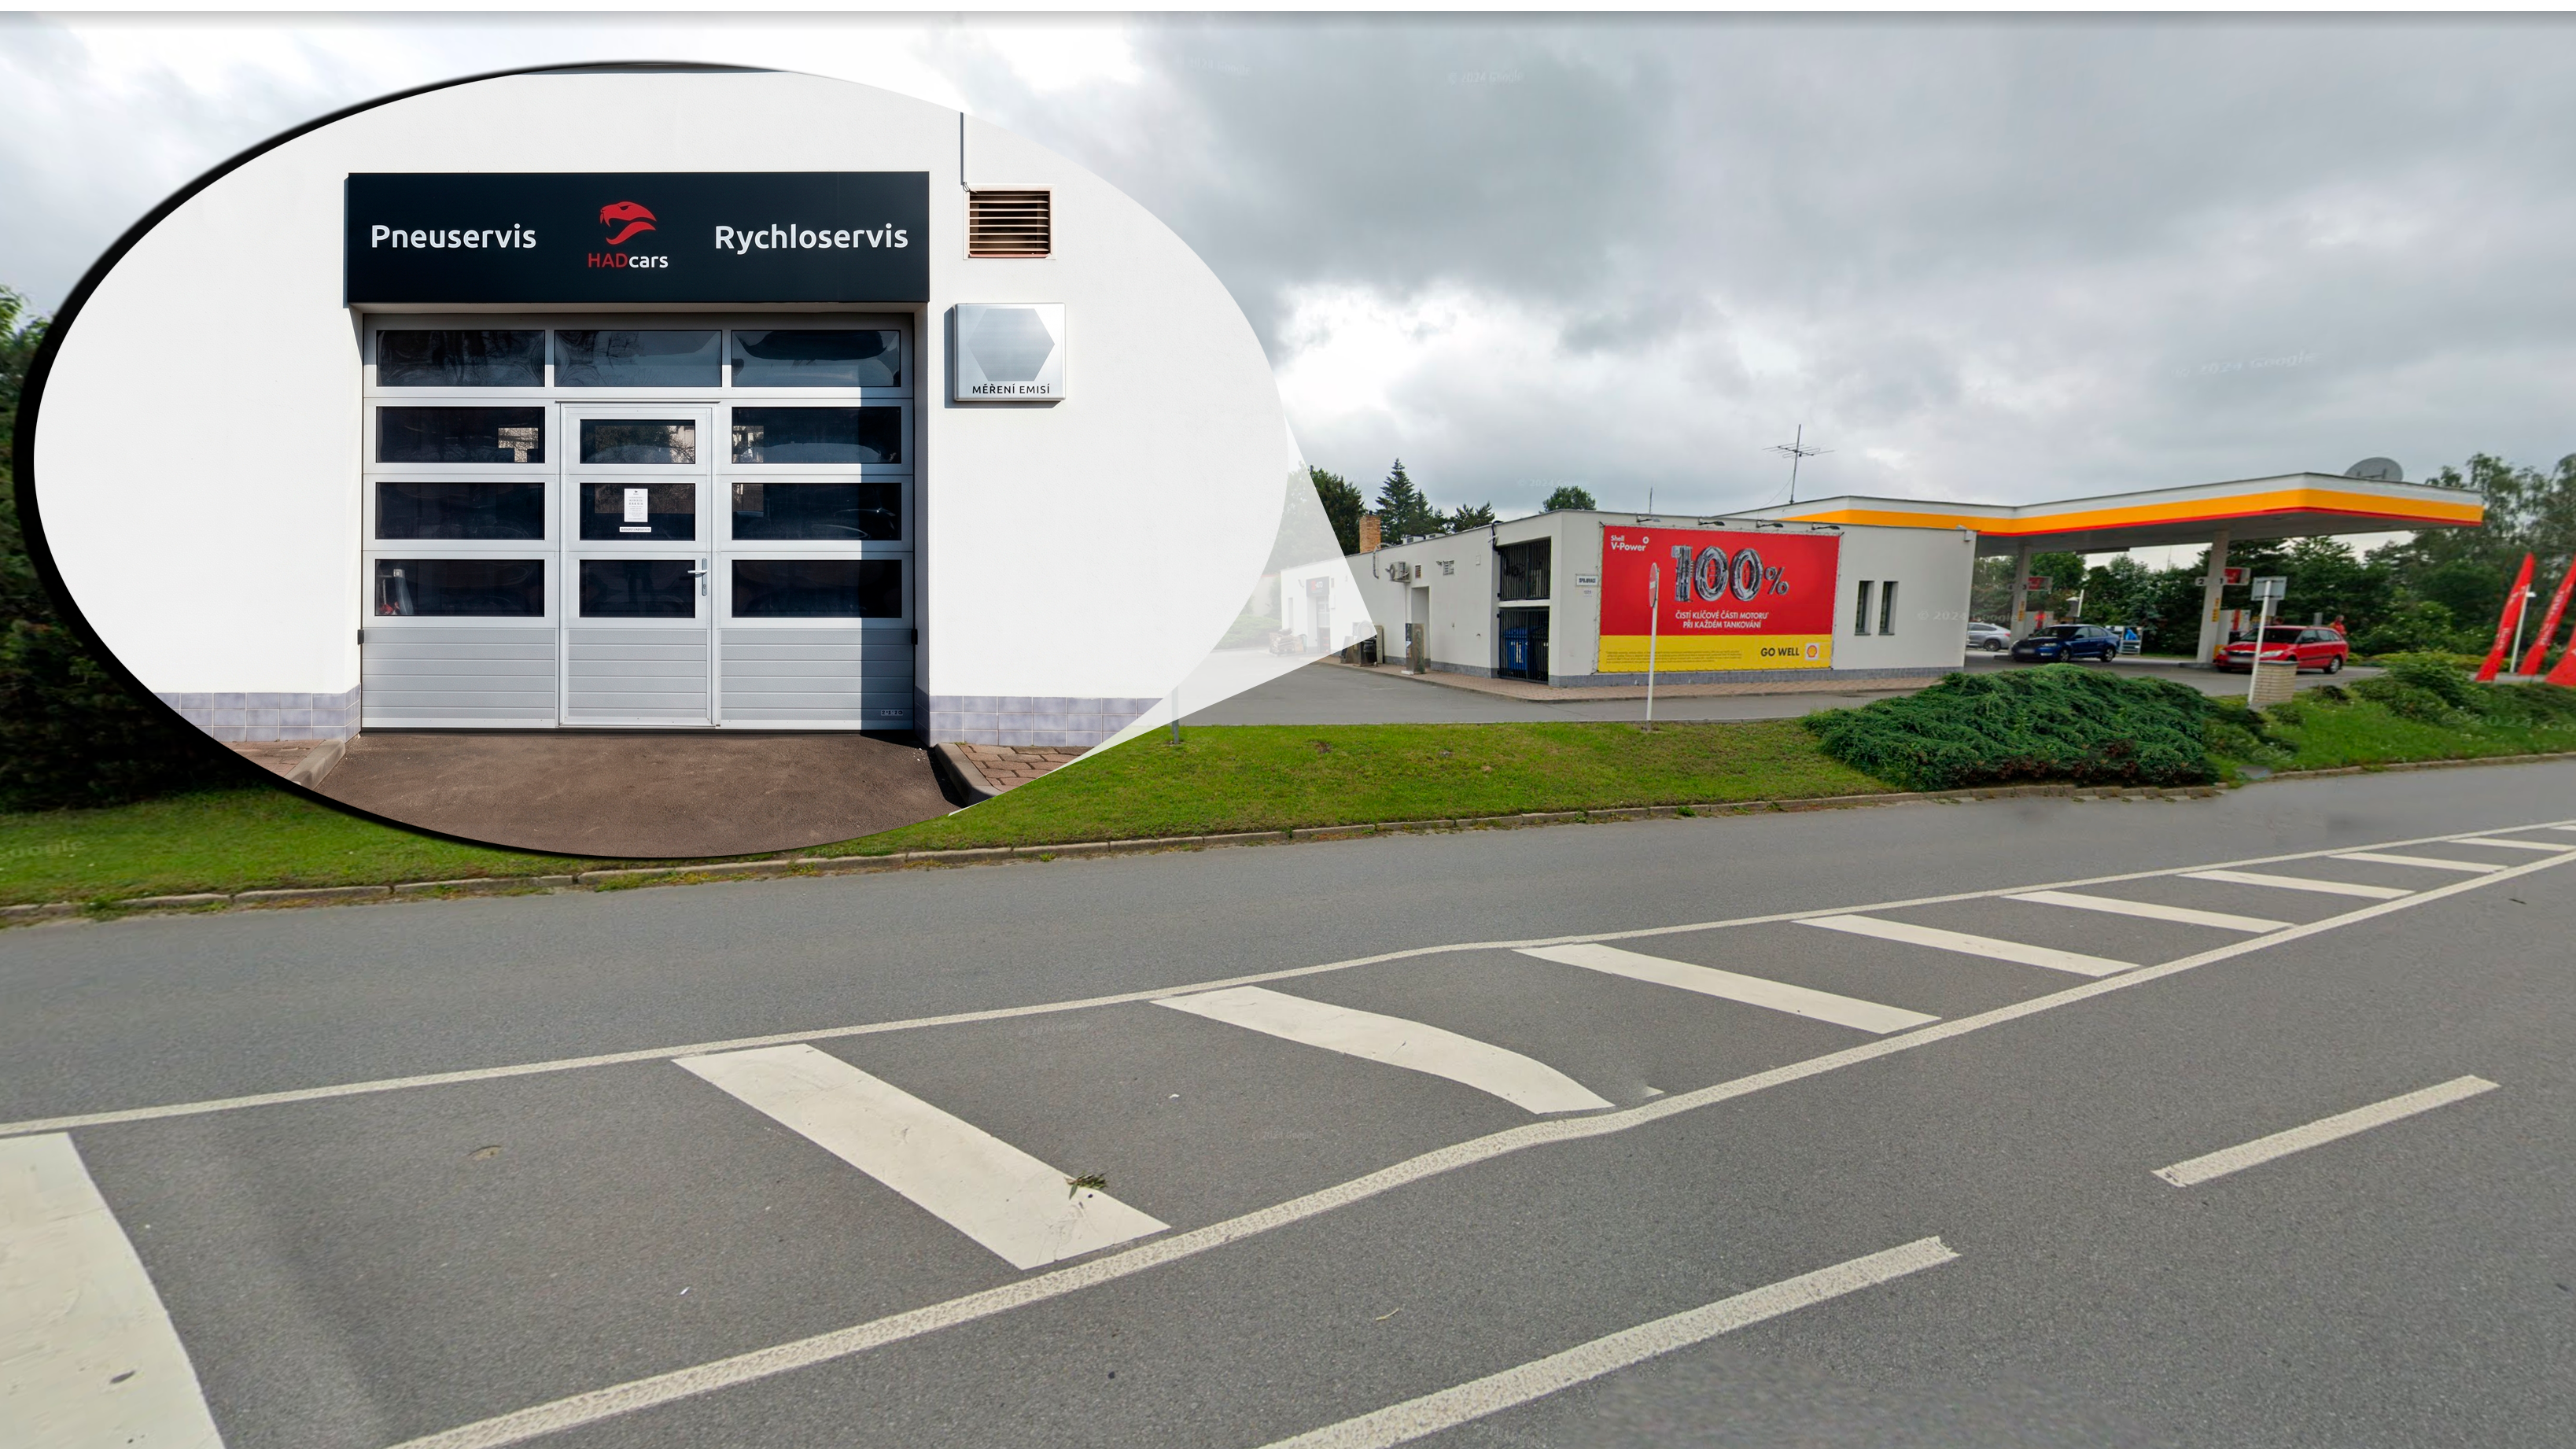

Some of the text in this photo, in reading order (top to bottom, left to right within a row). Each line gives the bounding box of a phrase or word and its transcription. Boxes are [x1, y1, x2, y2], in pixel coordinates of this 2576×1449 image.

[371, 223, 536, 249] Pneuservis
[715, 223, 908, 255] Rychloservis
[972, 383, 1050, 394] MĚŘENÍ EMISÍ
[1611, 542, 1646, 551] V-Power
[1675, 610, 1691, 620] ČISTÍ
[1692, 610, 1720, 620] KLÍČOVÉ
[1720, 610, 1738, 620] ČÁSTI
[1683, 619, 1761, 629] PŘI KAŽDÉM TANKOVÁNÍ
[1760, 647, 1800, 657] GO WELL
